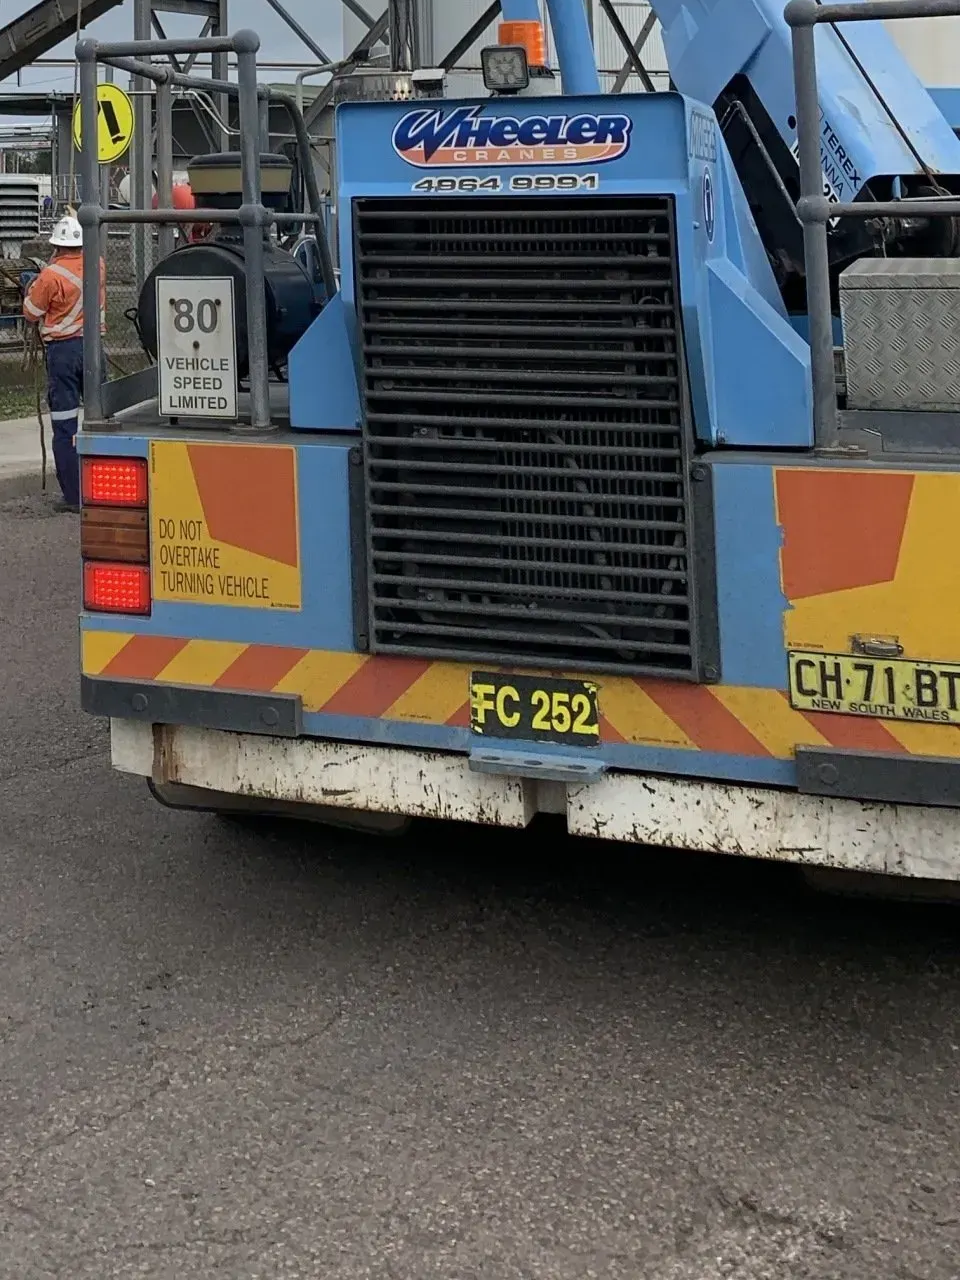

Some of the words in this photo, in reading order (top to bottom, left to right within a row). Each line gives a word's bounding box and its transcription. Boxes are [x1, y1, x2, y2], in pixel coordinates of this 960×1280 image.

[453, 148, 578, 161] CRANES
[822, 120, 862, 189] TEREX
[413, 176, 502, 193] 4964
[510, 174, 598, 191] 9991
[173, 298, 219, 334] 80
[165, 357, 230, 371] VEHICLE
[173, 376, 223, 390] SPEED
[169, 395, 228, 410] LIMITED
[159, 518, 176, 540] DO
[180, 520, 202, 541] NOT
[160, 544, 221, 569] OVERTAKE
[160, 570, 214, 596] TURNING
[218, 575, 270, 600] VEHICLE
[472, 683, 521, 728] FC
[530, 689, 600, 735] 252
[811, 698, 841, 711] NEW
[848, 702, 896, 716] SOUTH
[902, 706, 950, 721] WALES
